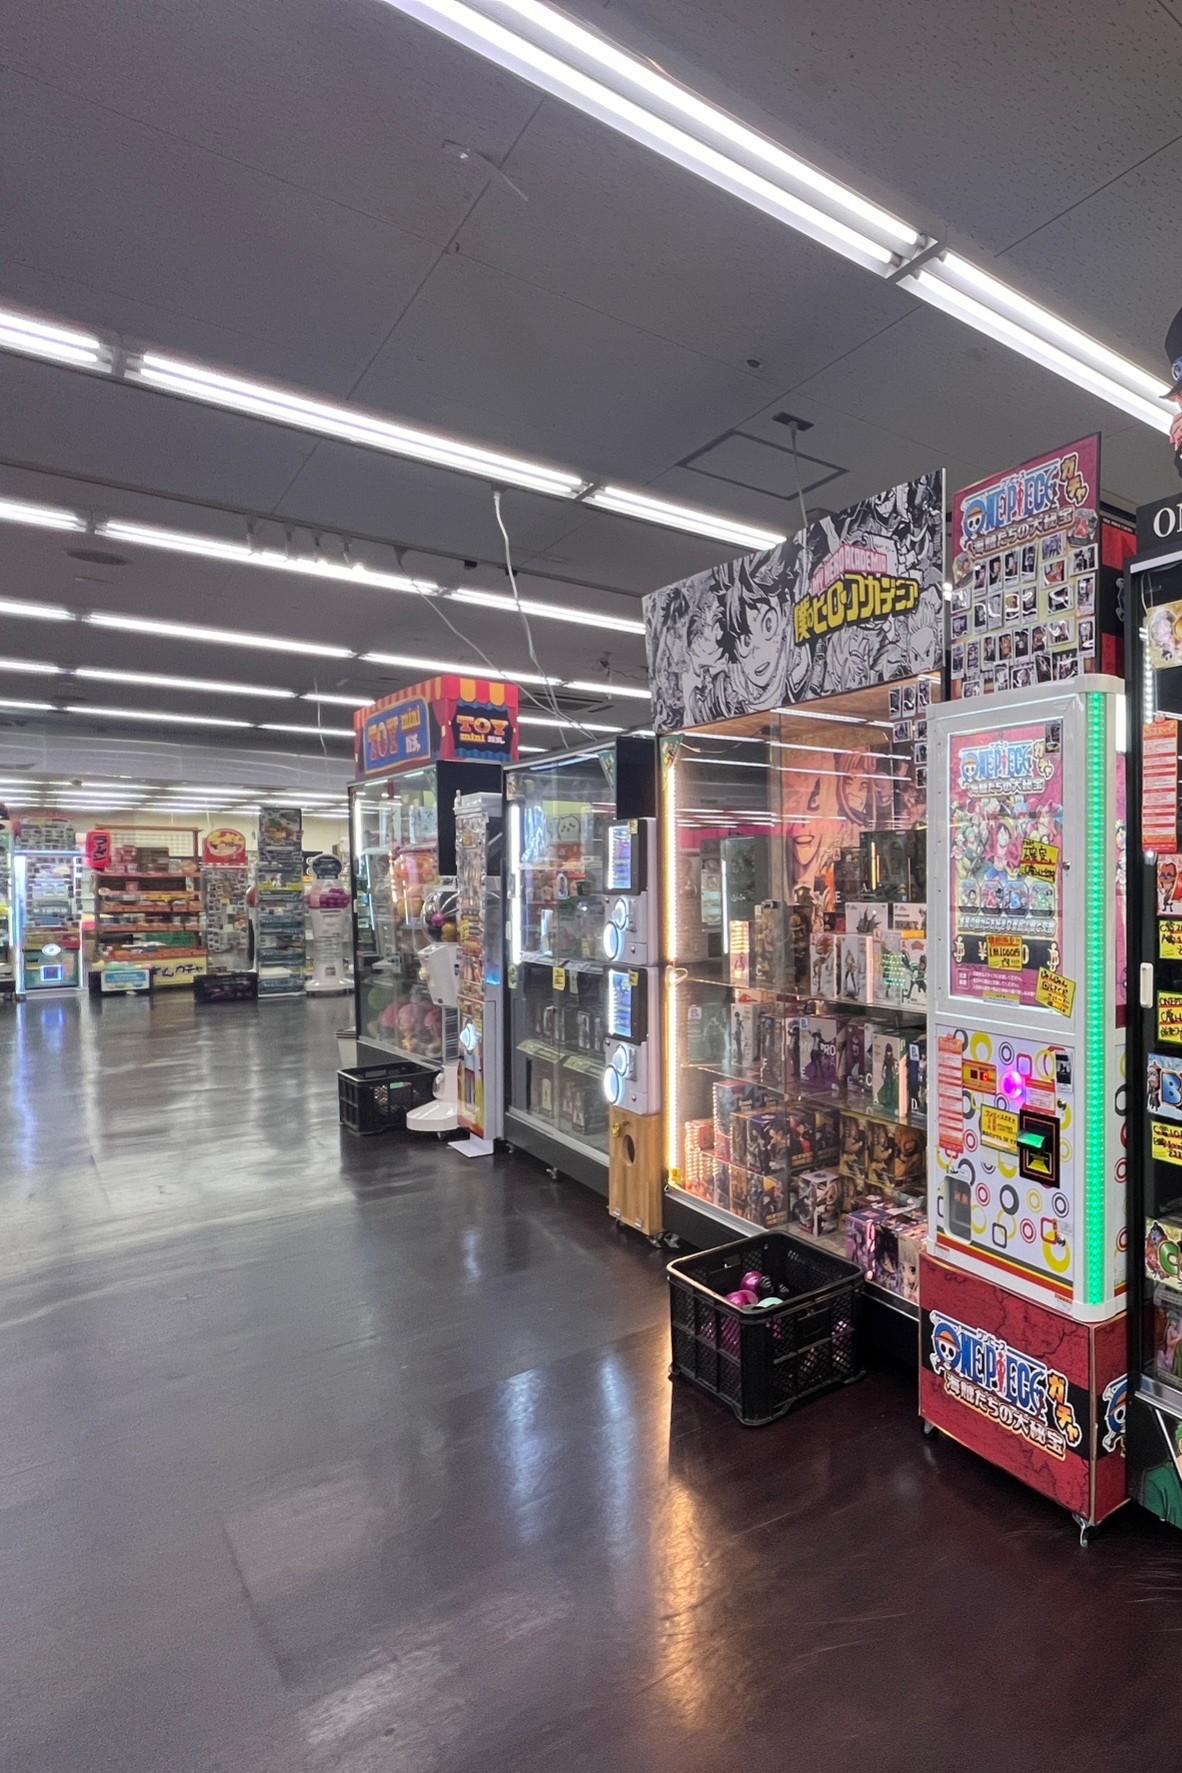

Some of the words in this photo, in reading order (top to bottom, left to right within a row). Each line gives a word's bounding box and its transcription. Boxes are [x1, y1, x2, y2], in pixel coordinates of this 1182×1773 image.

[962, 486, 1006, 540] ONE
[1007, 465, 1062, 523] PIECE
[793, 573, 920, 644] 僕のヒーローアカデミア
[368, 715, 399, 762] TOY
[456, 714, 510, 737] TOY
[459, 732, 487, 744] mini
[1159, 1069, 1182, 1104] B
[1158, 1240, 1180, 1275] C
[934, 1320, 984, 1385] ONE
[985, 1343, 1048, 1418] PIECE
[945, 1374, 1066, 1457] 海賊たちの大秘宝
[1047, 1372, 1081, 1444] ガチャ
